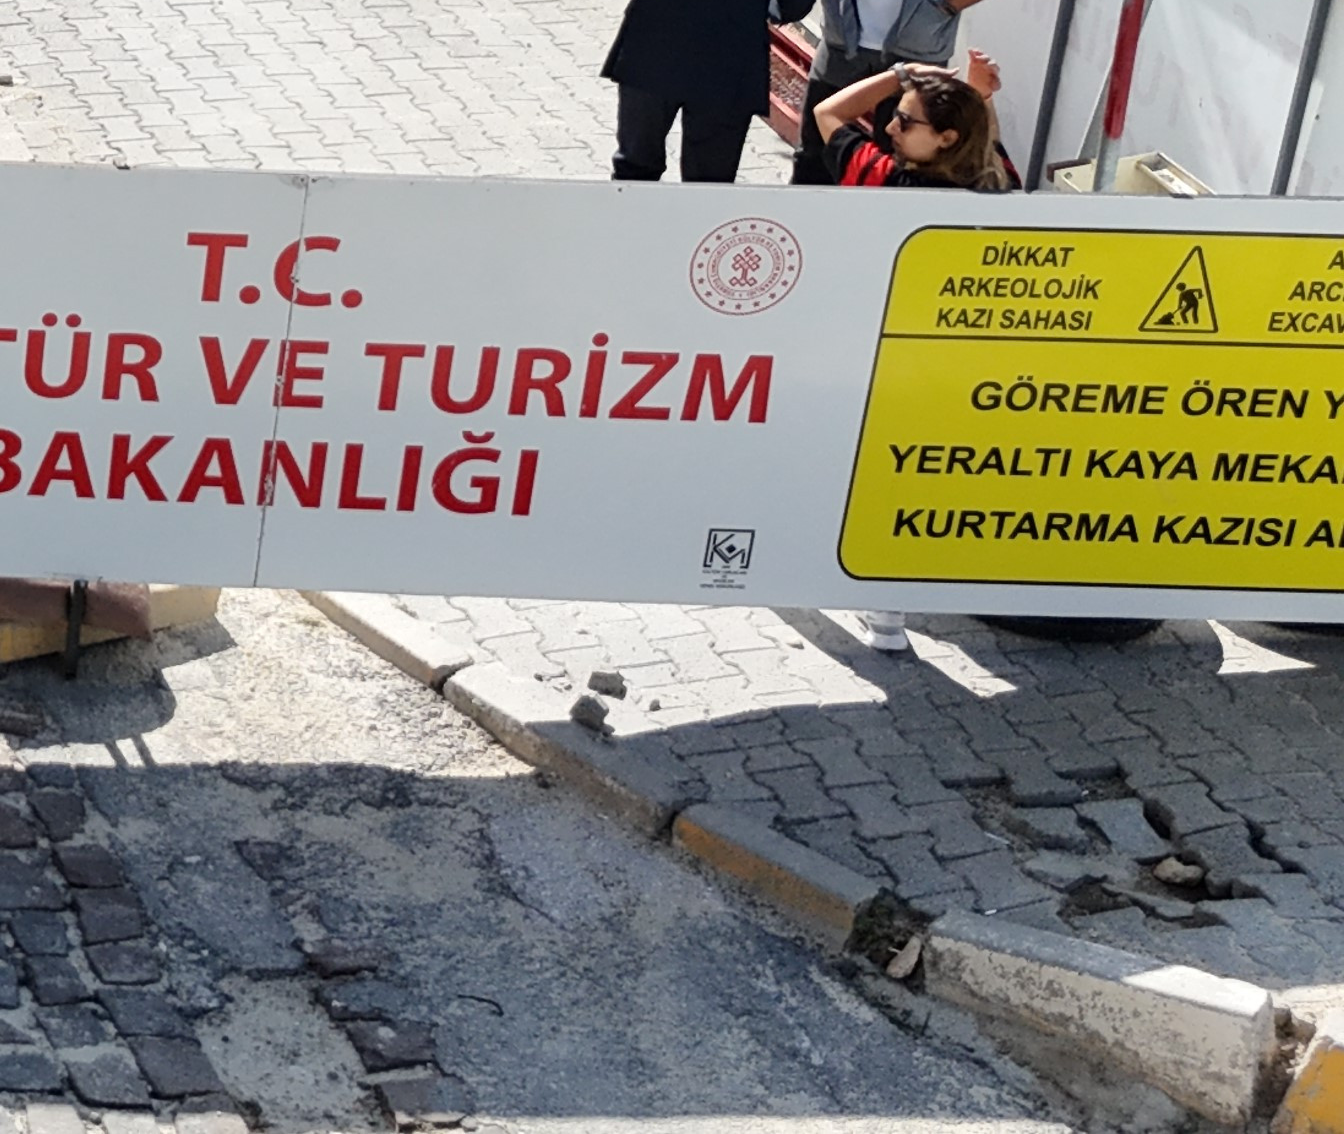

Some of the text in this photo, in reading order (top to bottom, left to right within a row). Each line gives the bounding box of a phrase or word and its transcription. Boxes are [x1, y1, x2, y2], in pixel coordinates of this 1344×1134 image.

[187, 233, 362, 308] T.C.
[981, 240, 1076, 268] DİKKAT
[938, 273, 1102, 300] ARKEOLOJİK
[1287, 279, 1344, 302] ARC
[936, 307, 1093, 331] KAZI SAHASI
[201, 337, 329, 408] VE
[365, 333, 773, 423] TURİZM
[970, 375, 1169, 415] GÖREME
[1181, 379, 1310, 419] ÖREN
[889, 444, 1344, 485] YERALTI KAYA MEKA
[892, 508, 1139, 543] KURTARMA
[1152, 515, 1297, 547] KAZISI
